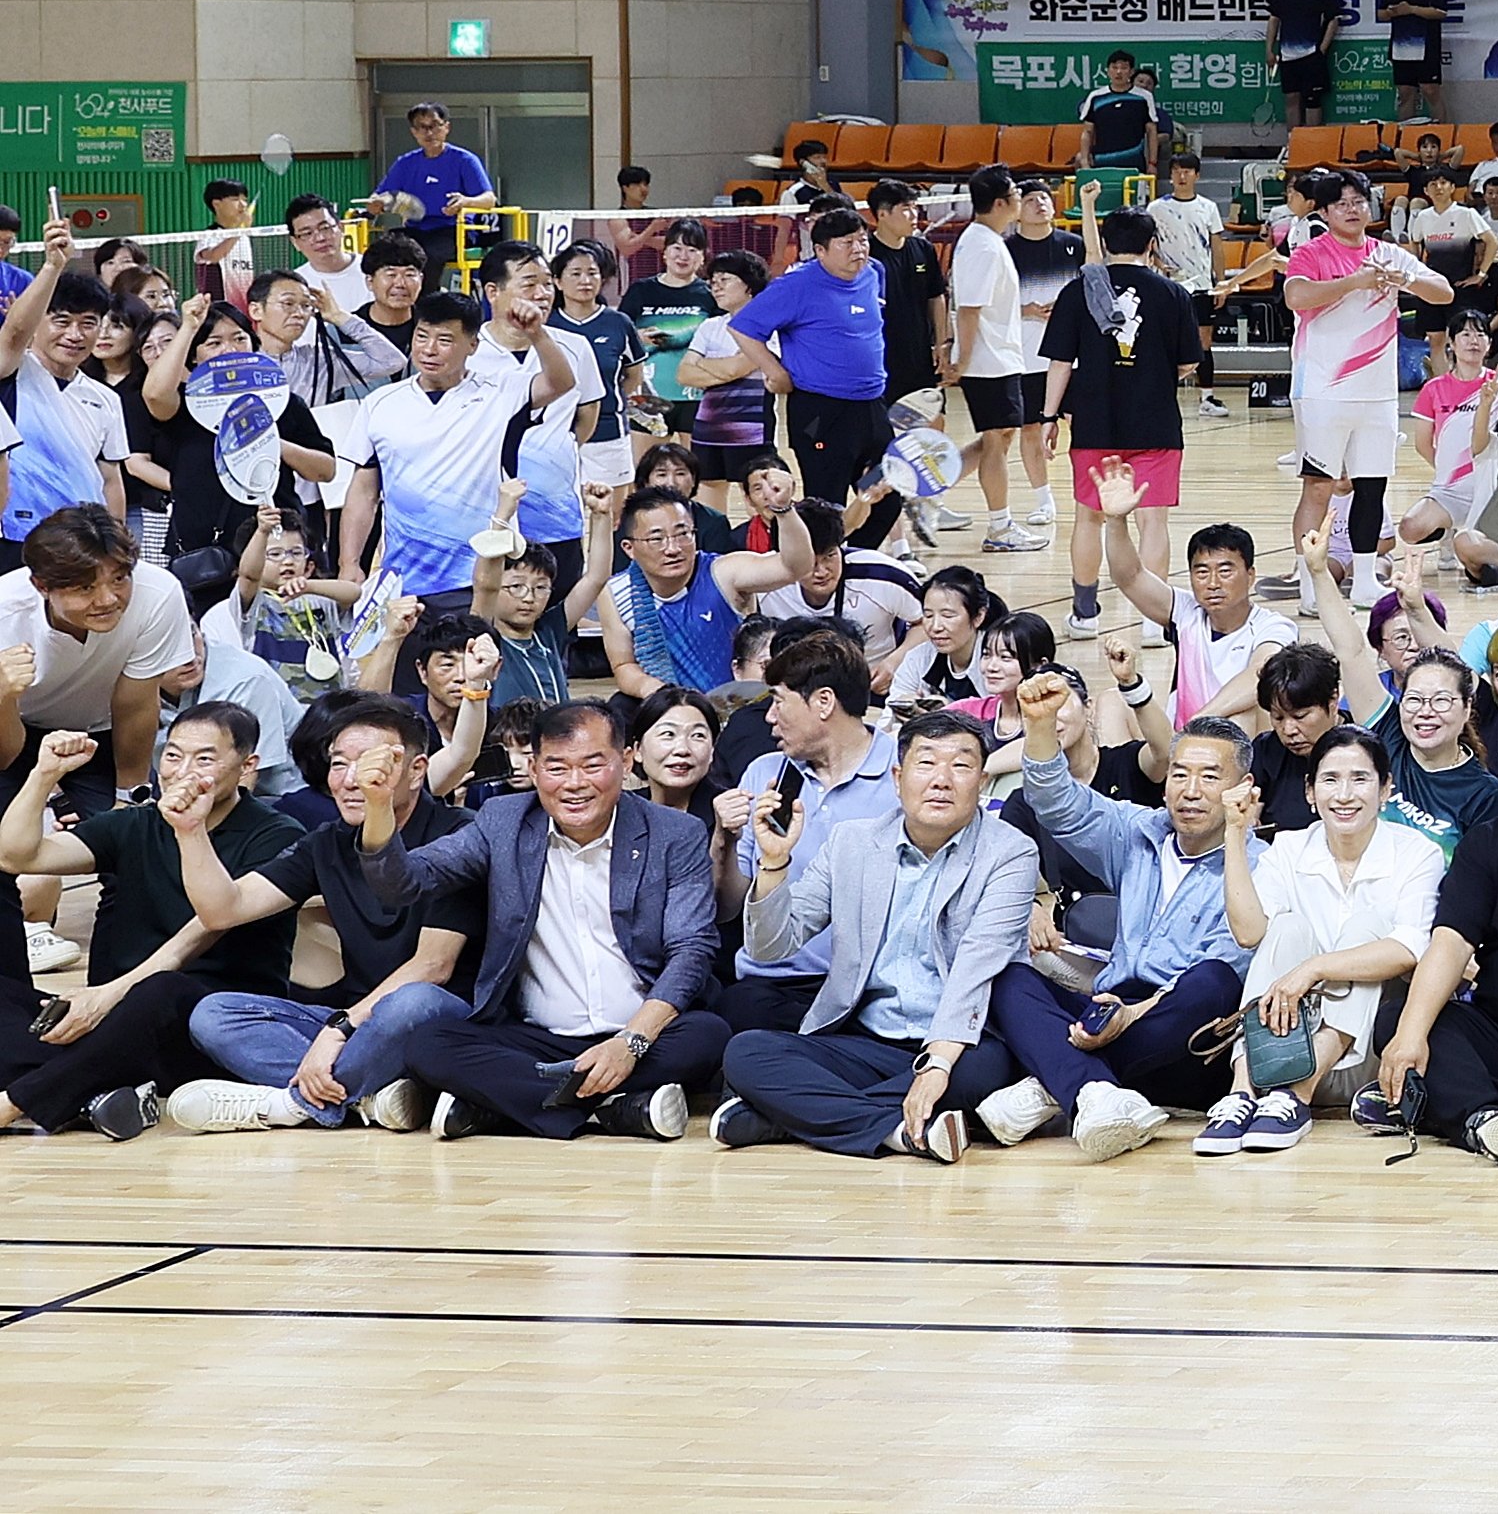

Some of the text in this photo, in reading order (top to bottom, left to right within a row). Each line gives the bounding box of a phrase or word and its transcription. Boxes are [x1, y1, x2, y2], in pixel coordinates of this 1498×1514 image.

[546, 223, 568, 248] 12
[655, 306, 702, 316] MIKAZ
[1251, 381, 1267, 397] 20
[1389, 792, 1451, 835] MIKAZ
